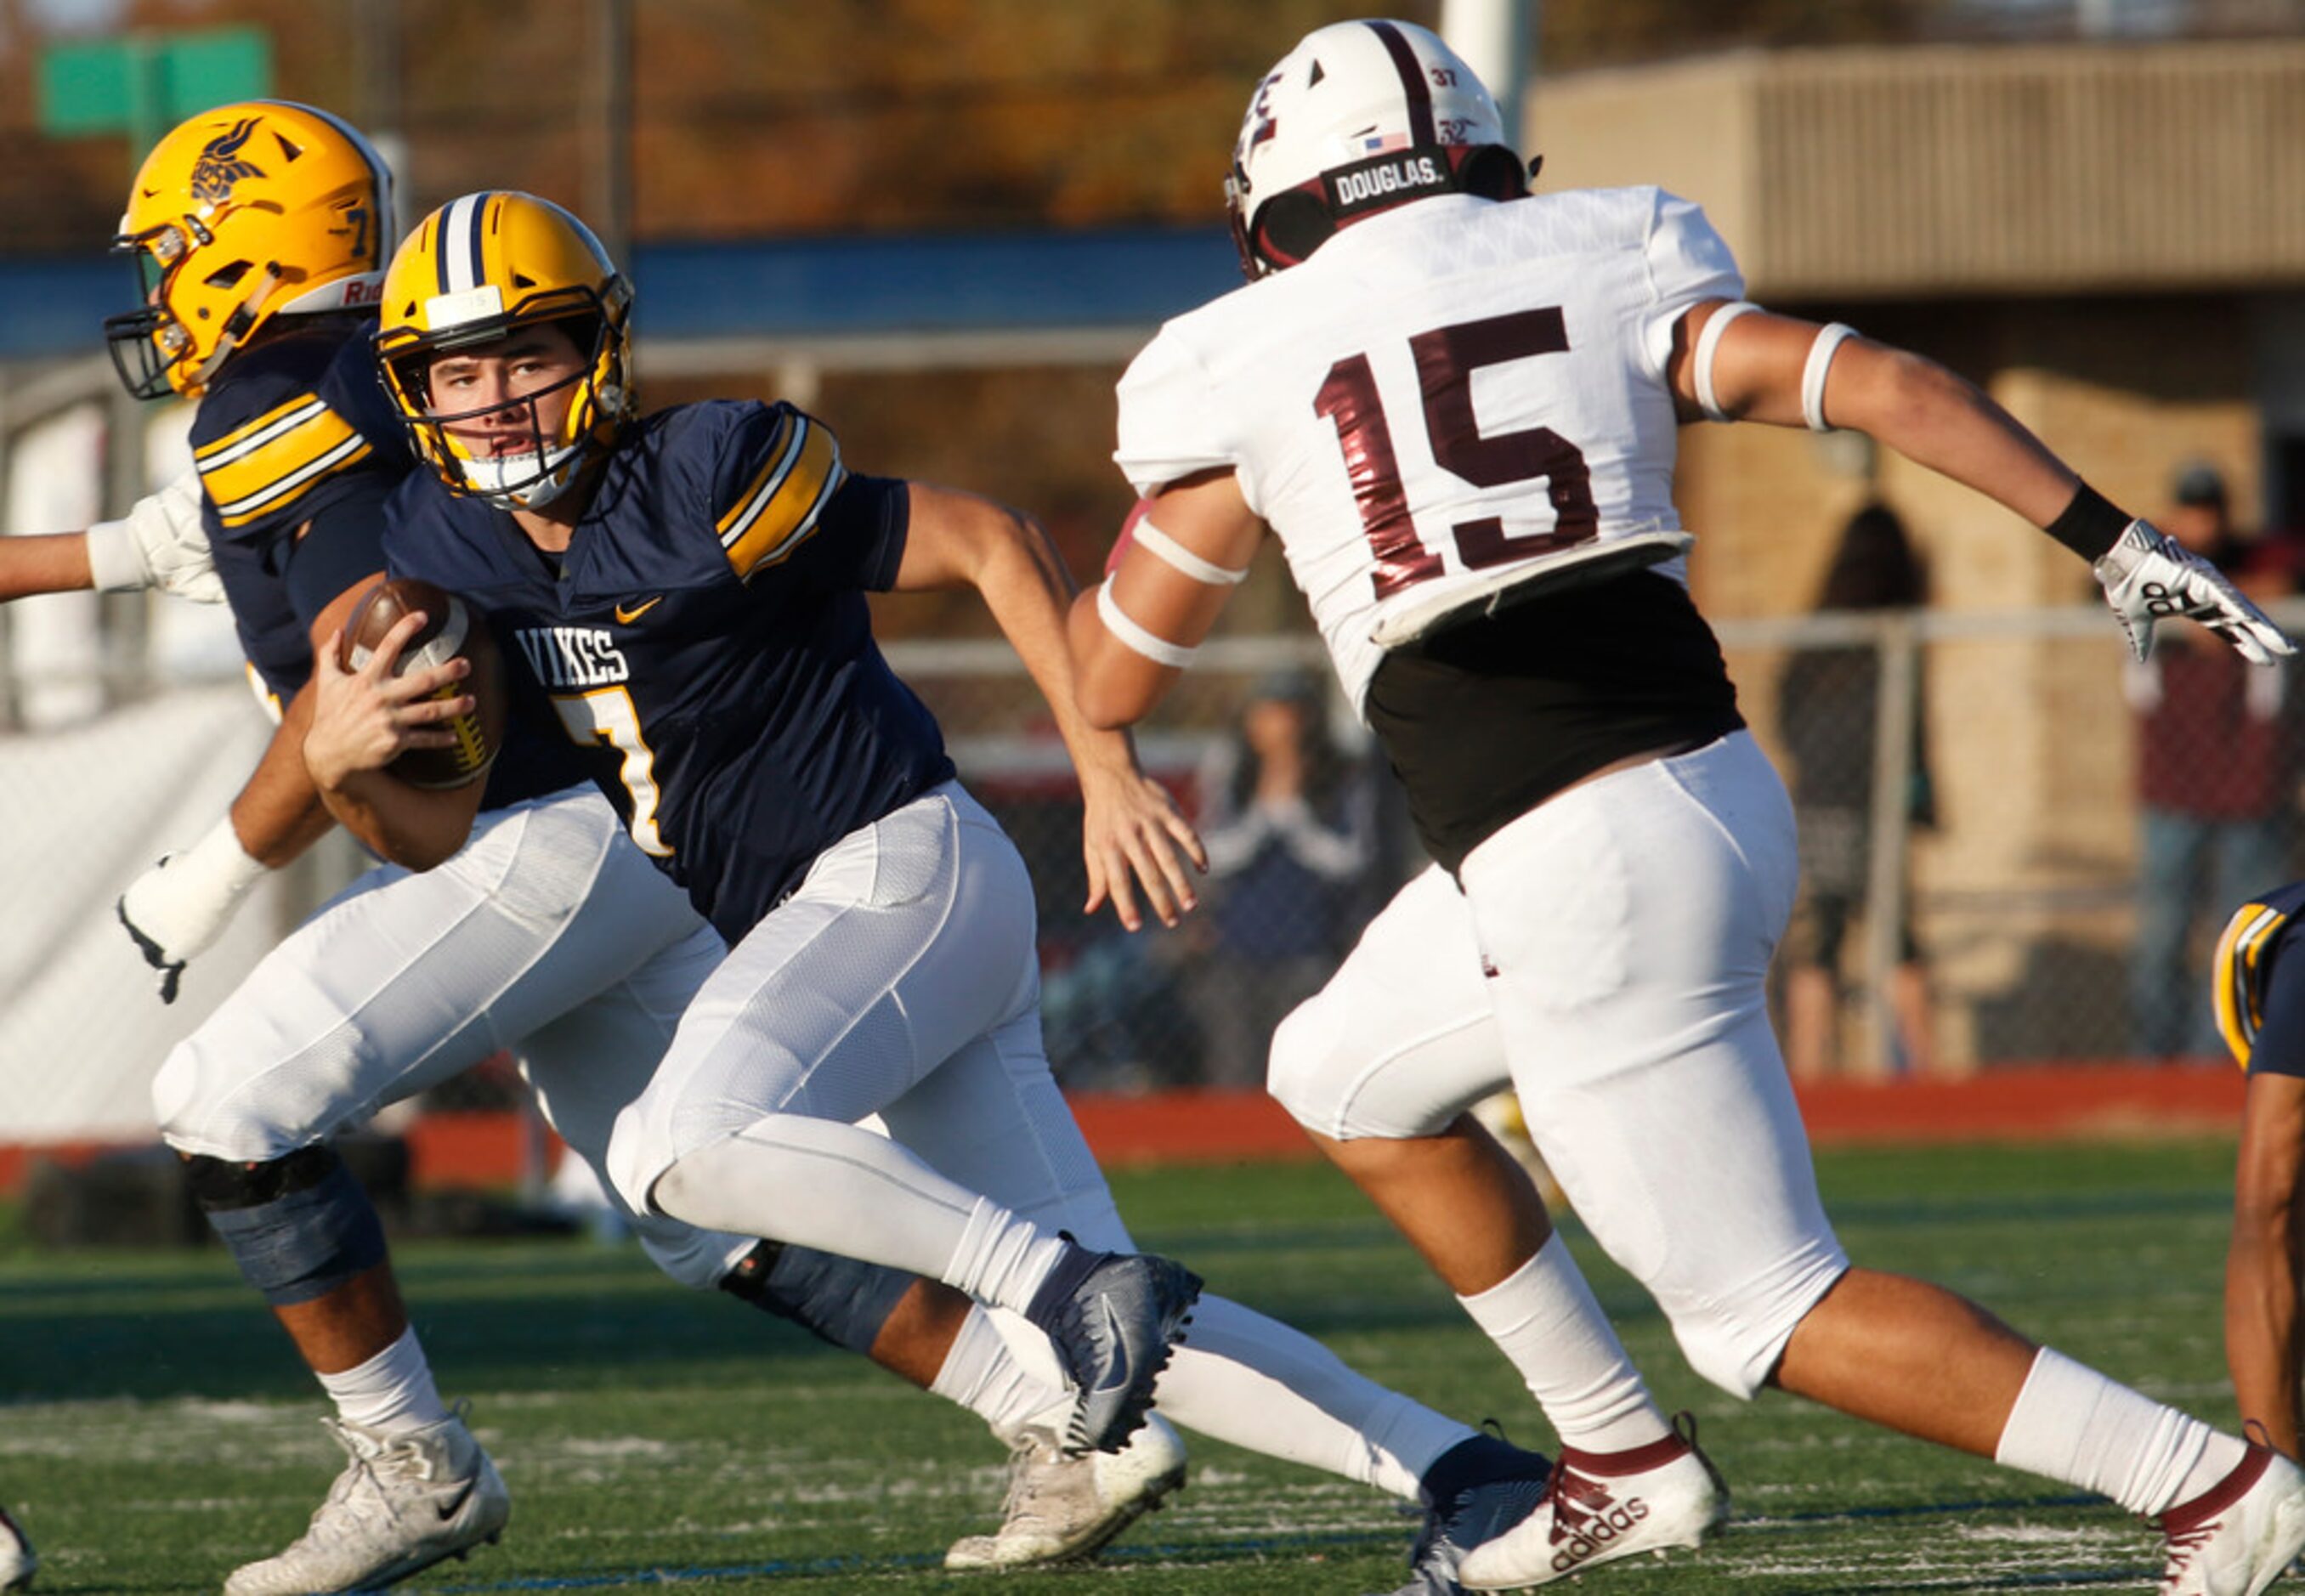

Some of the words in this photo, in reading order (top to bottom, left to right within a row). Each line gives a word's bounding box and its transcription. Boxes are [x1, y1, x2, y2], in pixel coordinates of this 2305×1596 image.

[1431, 69, 1457, 87] 37
[346, 208, 367, 257] 7
[1313, 305, 1600, 602] 15
[515, 627, 629, 687] VIKES
[550, 684, 676, 857] 7
[1551, 1497, 1649, 1571] adidas
